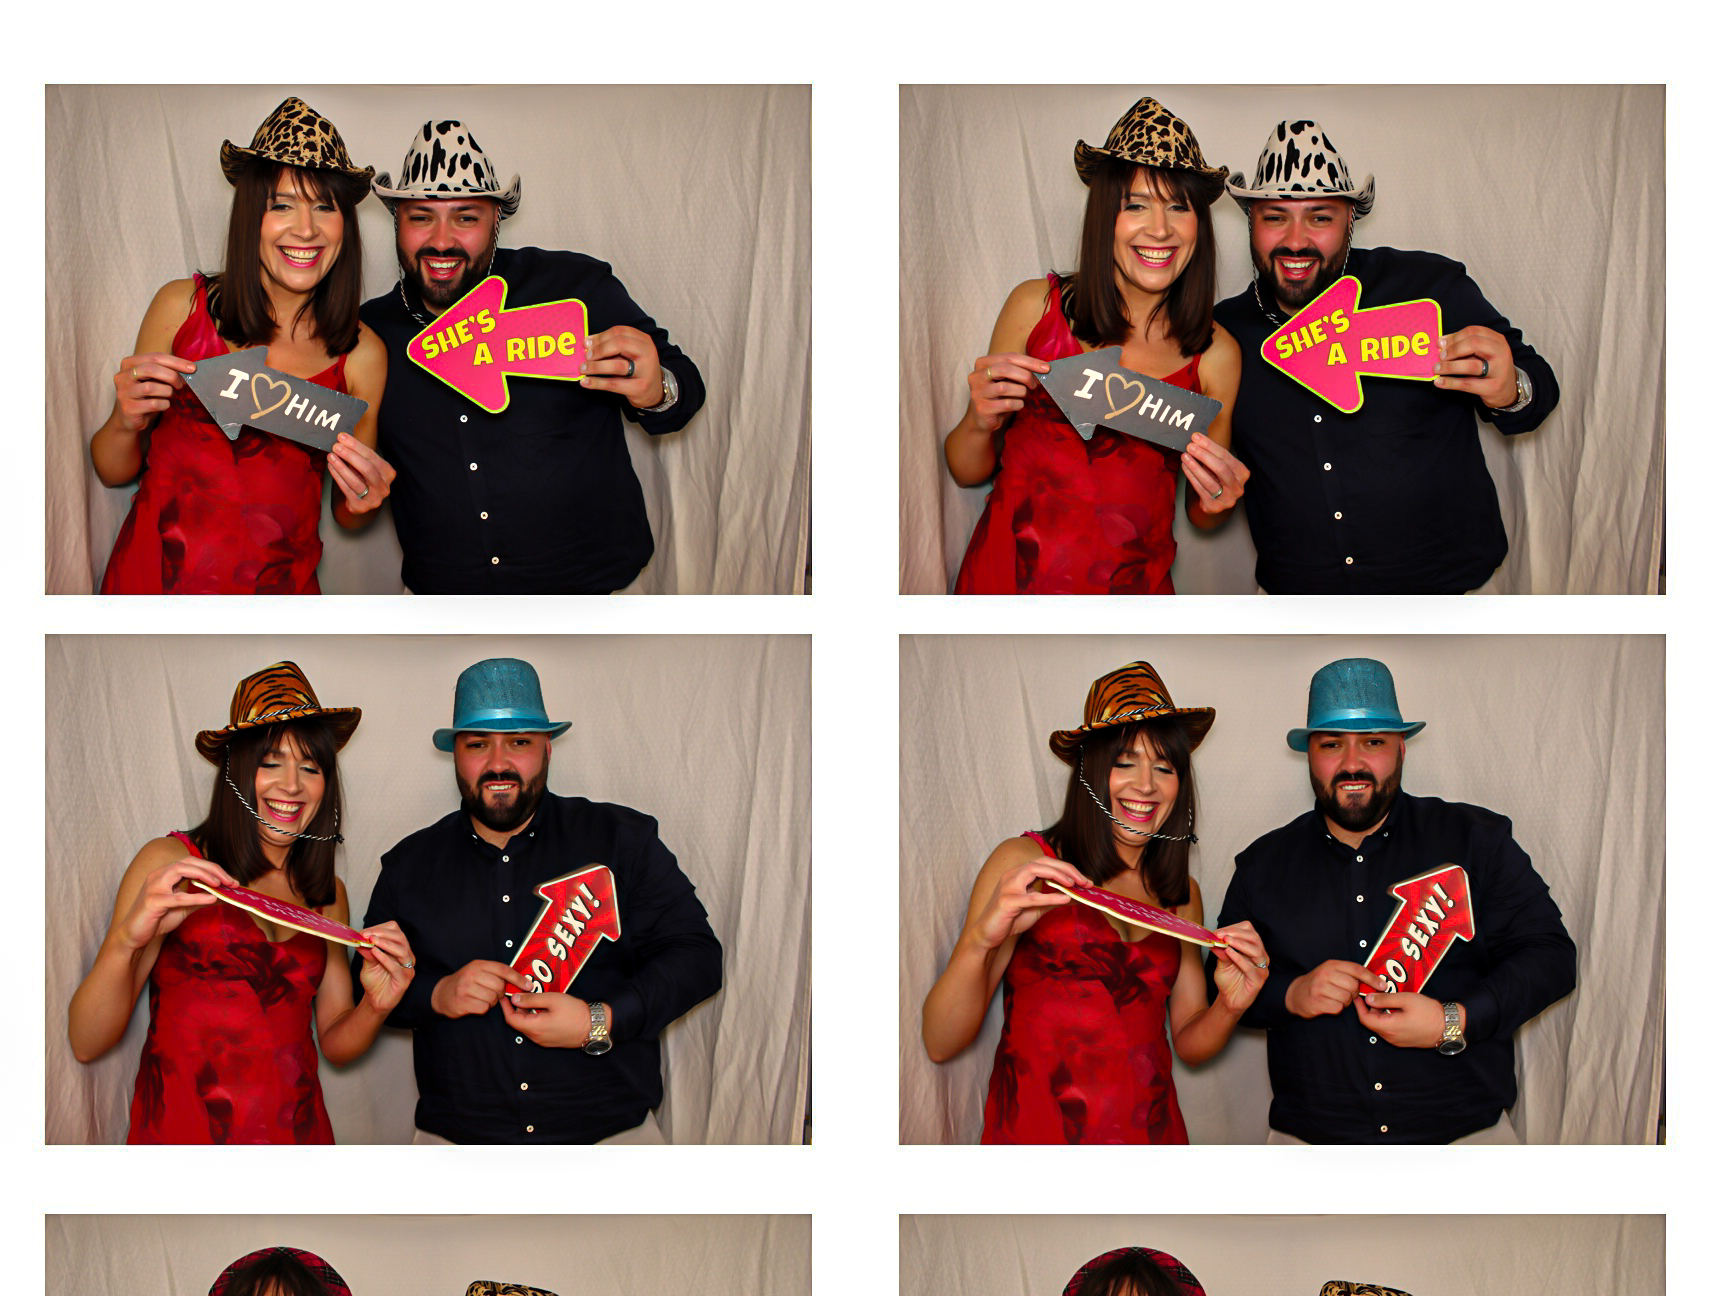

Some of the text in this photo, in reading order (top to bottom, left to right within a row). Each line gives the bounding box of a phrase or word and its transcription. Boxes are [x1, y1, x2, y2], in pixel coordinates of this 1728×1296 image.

[421, 308, 496, 360] SHE'S
[473, 341, 493, 366] A
[1275, 308, 1350, 360] SHE'S
[1327, 341, 1347, 366] A
[219, 368, 341, 431] I HIM
[1073, 368, 1195, 431] I HIM
[548, 883, 600, 960] SEXY!
[1402, 883, 1454, 960] SEXY!
